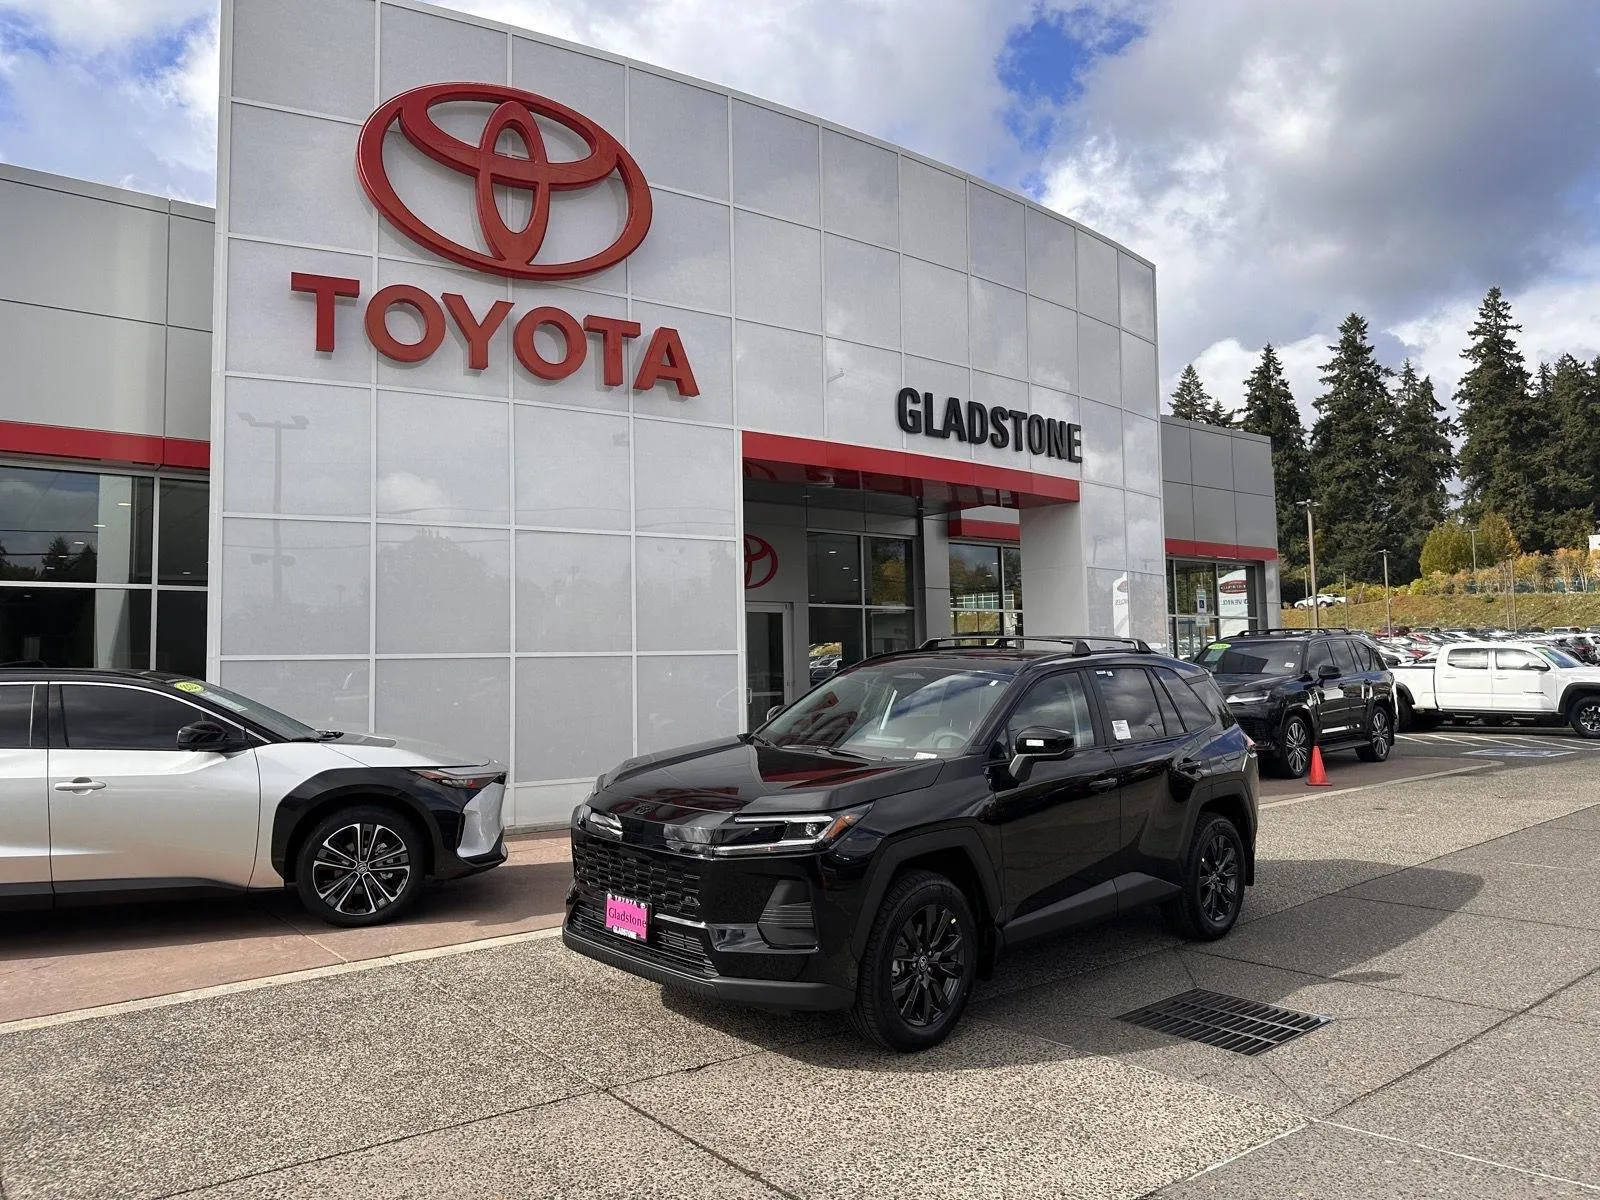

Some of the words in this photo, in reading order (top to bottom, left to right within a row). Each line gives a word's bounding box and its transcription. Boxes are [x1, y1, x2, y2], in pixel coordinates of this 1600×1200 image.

[291, 271, 700, 398] TOYOTA
[897, 387, 1083, 463] GLADSTONE
[608, 907, 647, 928] Gladstone
